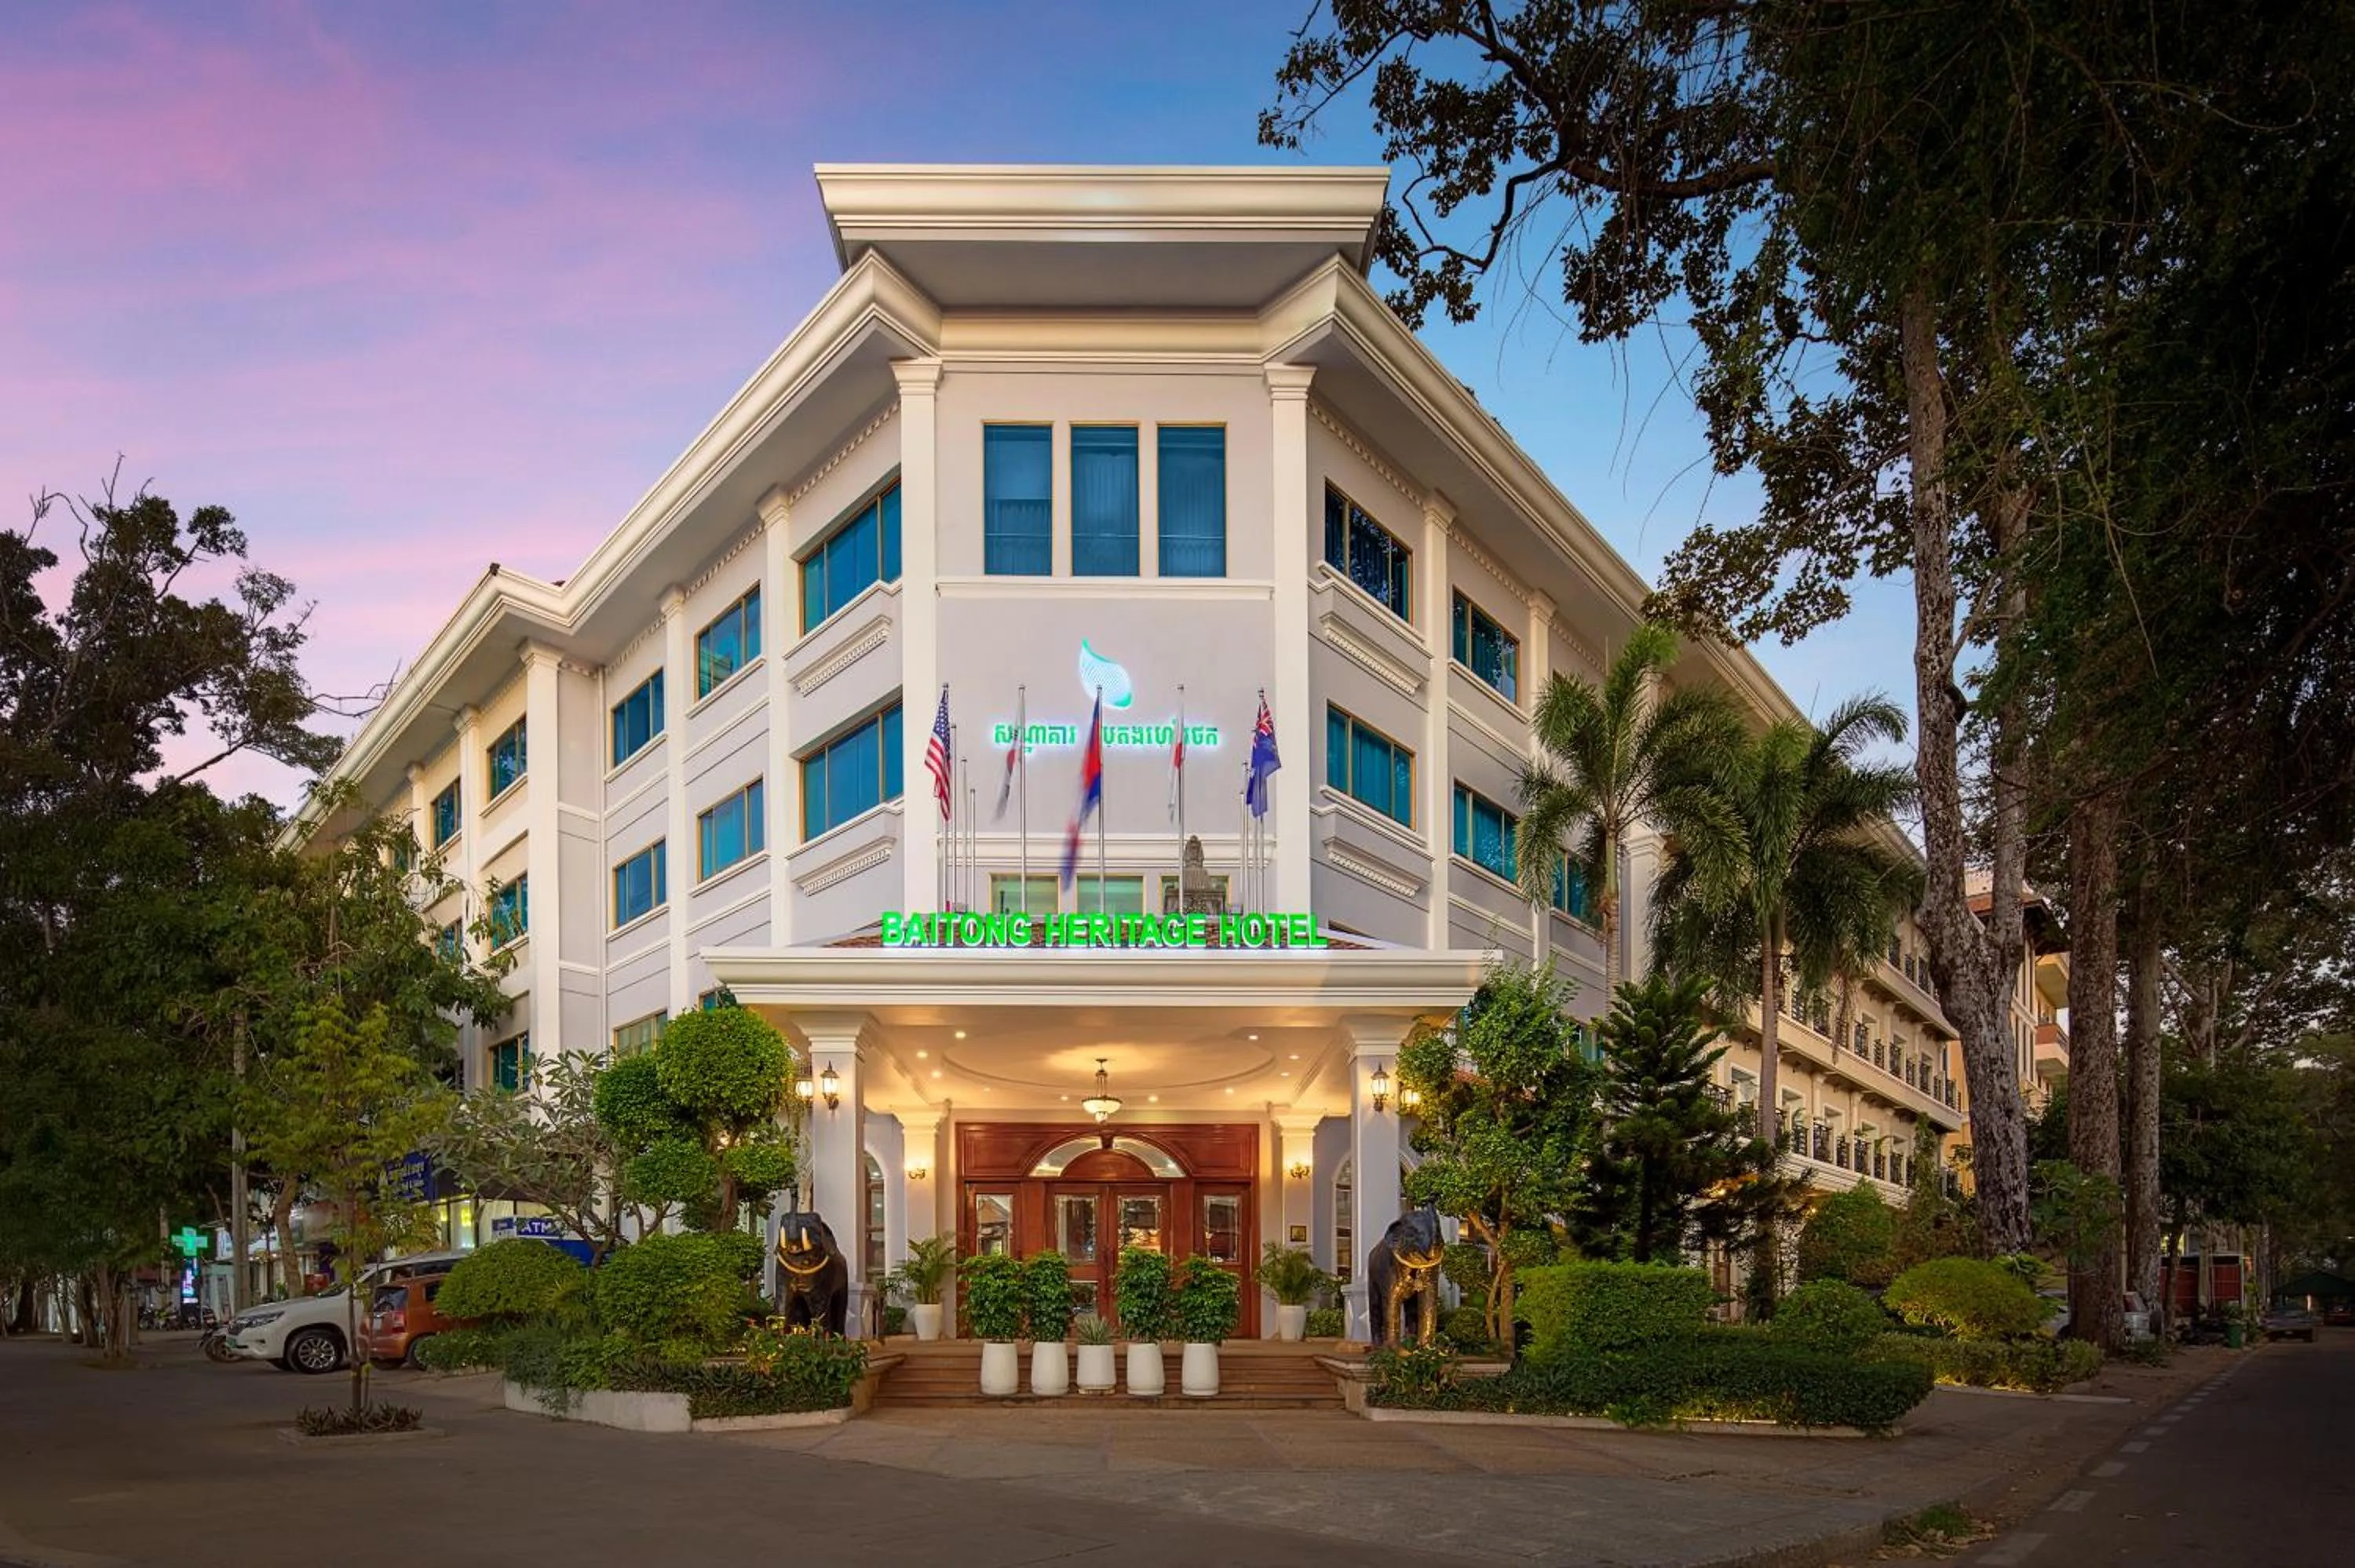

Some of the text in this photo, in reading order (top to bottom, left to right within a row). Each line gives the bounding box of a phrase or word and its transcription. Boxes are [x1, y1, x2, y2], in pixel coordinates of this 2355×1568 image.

[882, 910, 1328, 949] BAITONG HERITAGE HOTEL
[521, 1221, 552, 1234] ATM
